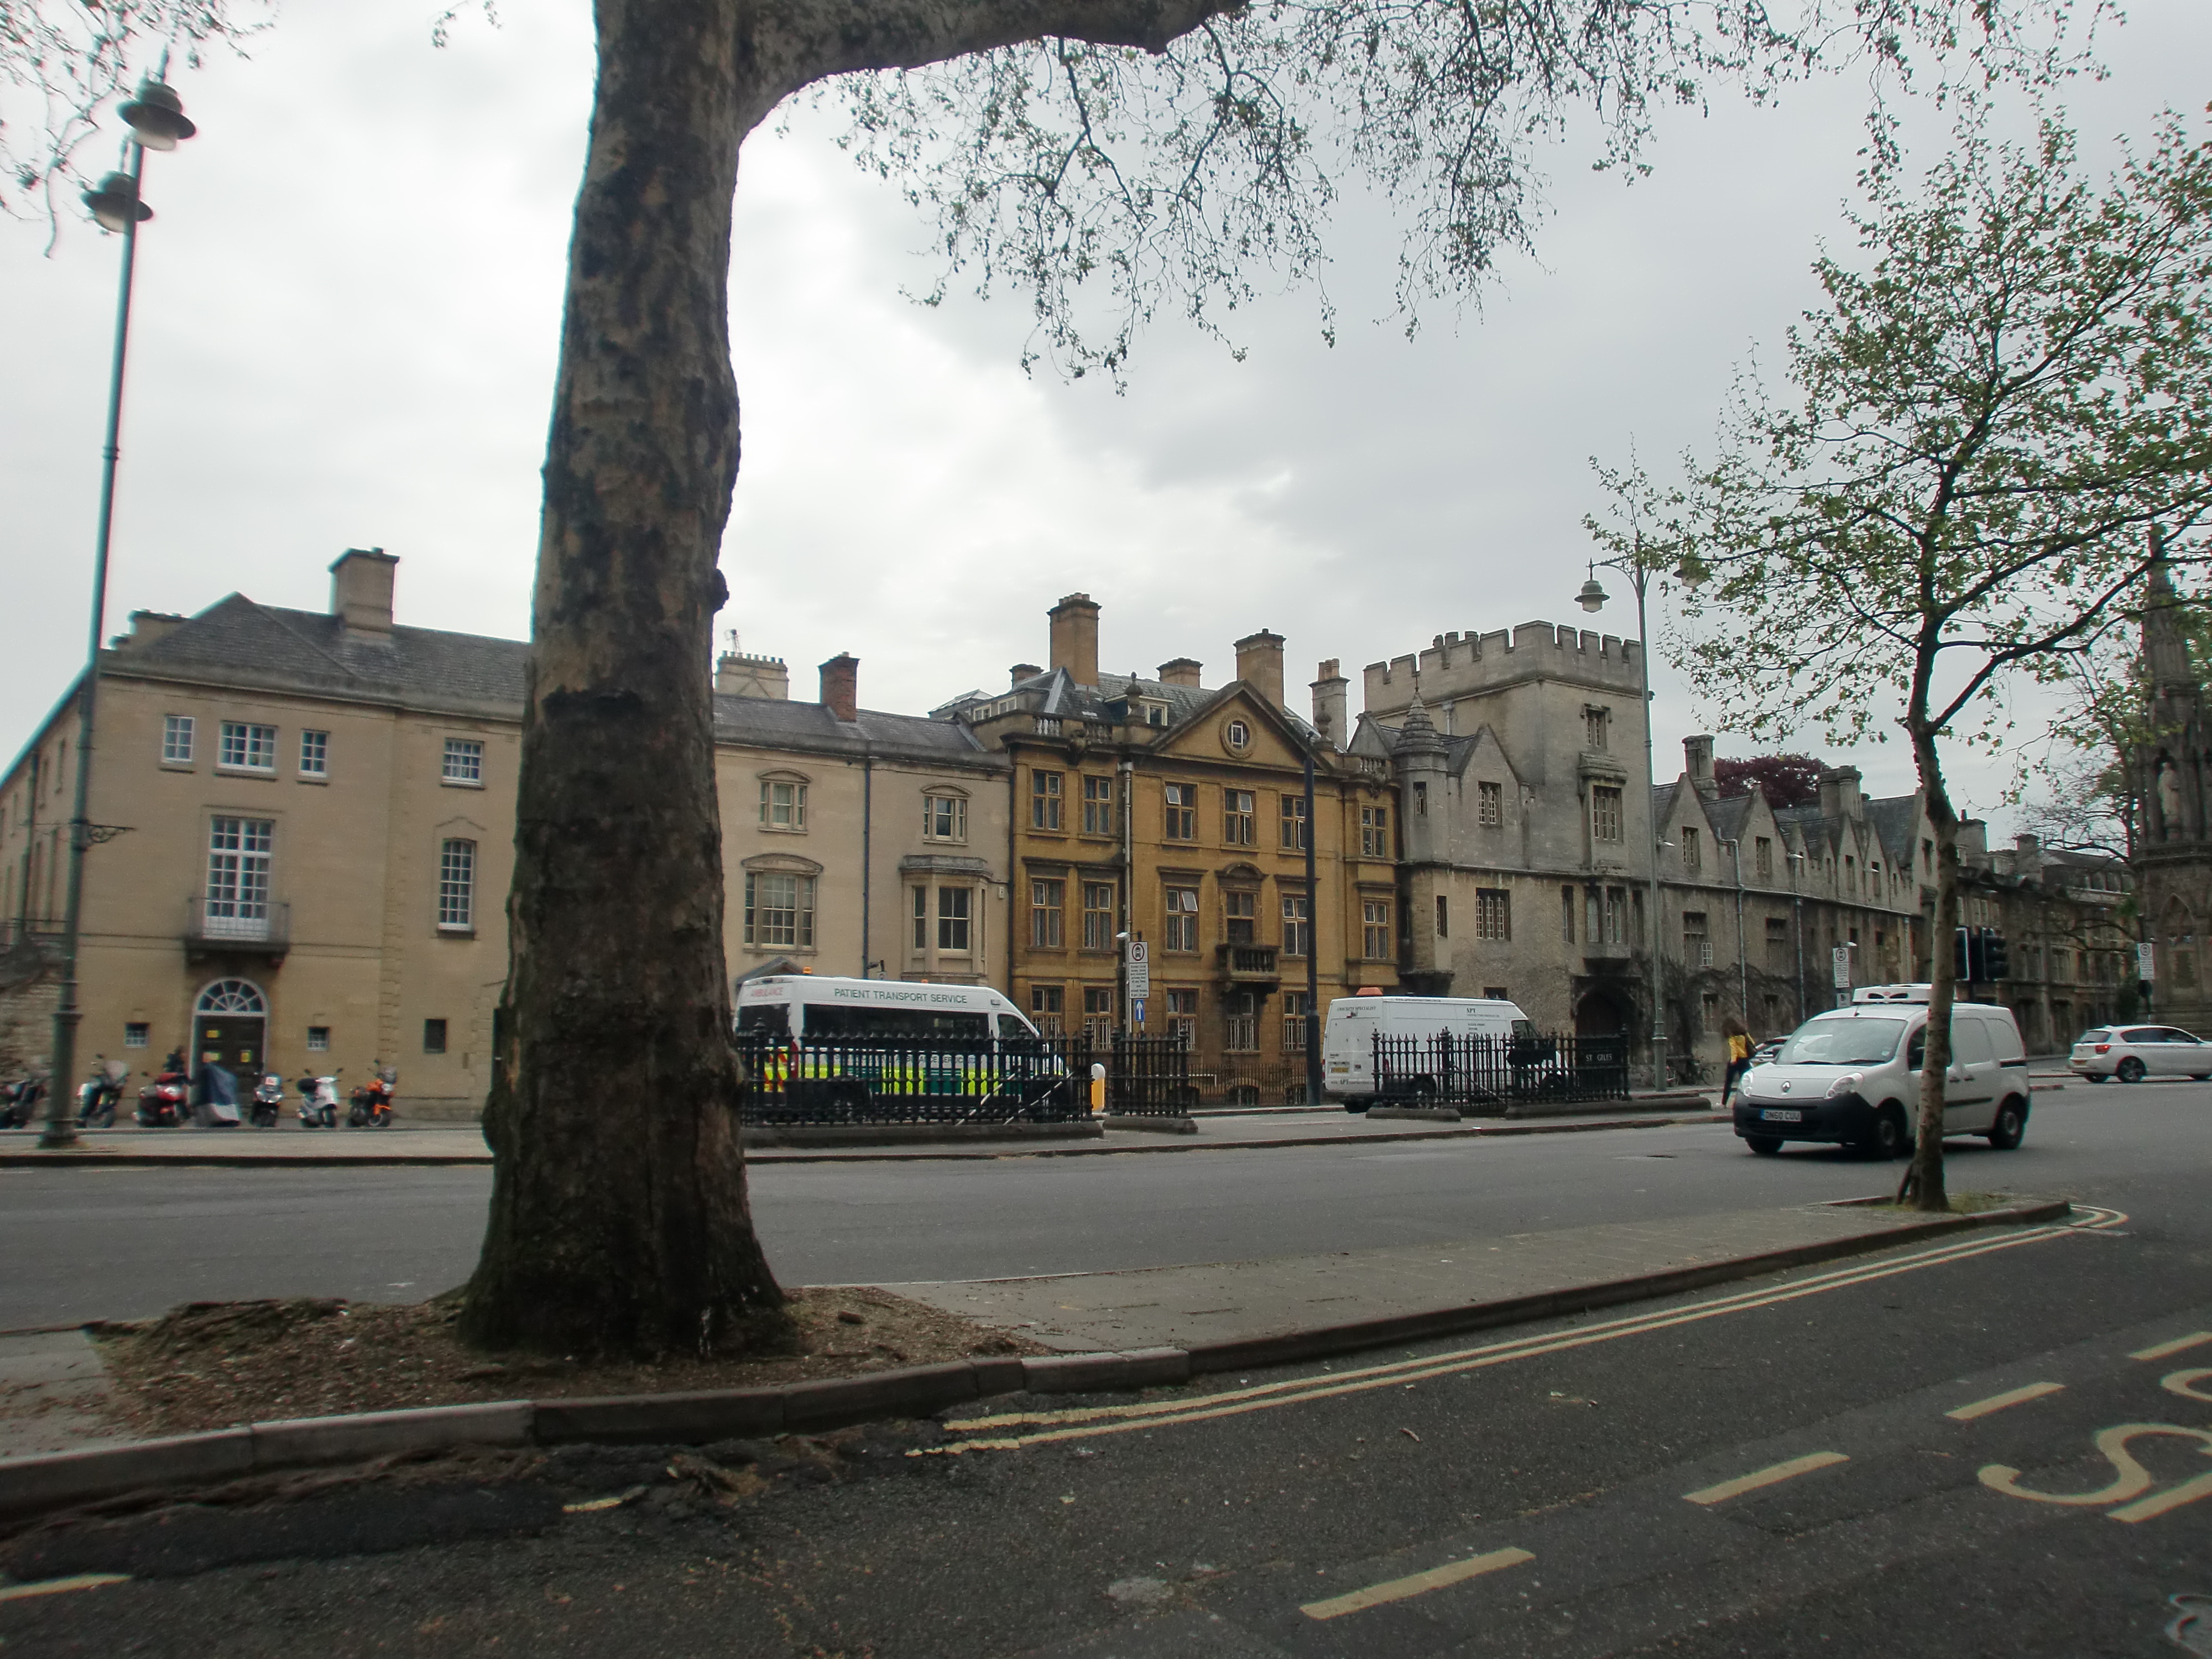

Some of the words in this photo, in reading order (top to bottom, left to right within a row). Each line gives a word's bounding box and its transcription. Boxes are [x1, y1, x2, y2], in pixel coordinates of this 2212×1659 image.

[834, 988, 870, 998] PATIENT
[873, 990, 927, 1001] TRANSPORT
[931, 994, 967, 1004] SERVICE
